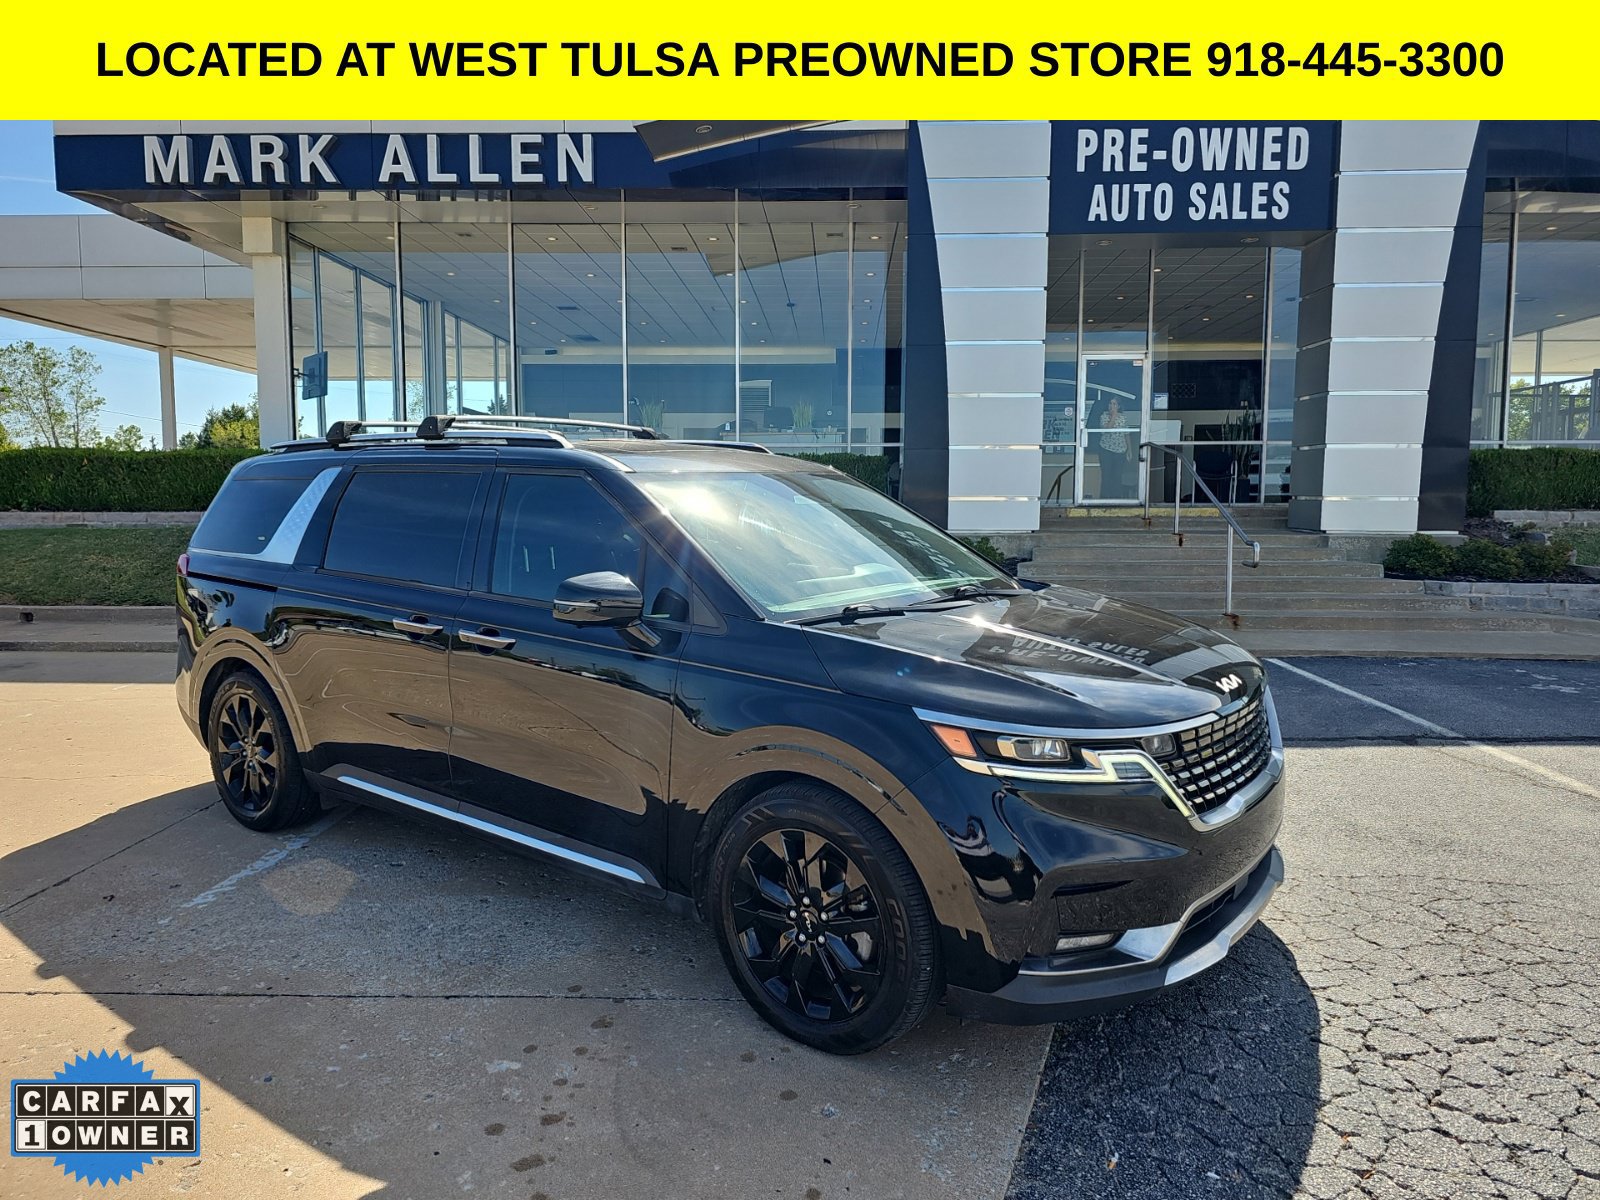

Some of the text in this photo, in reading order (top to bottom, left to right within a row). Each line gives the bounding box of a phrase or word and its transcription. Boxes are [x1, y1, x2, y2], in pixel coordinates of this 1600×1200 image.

[143, 133, 595, 184] MARK ALLEN
[1076, 126, 1310, 172] PRE-OWNED
[1087, 181, 1290, 222] AUTO SALES
[1215, 673, 1243, 693] KIA
